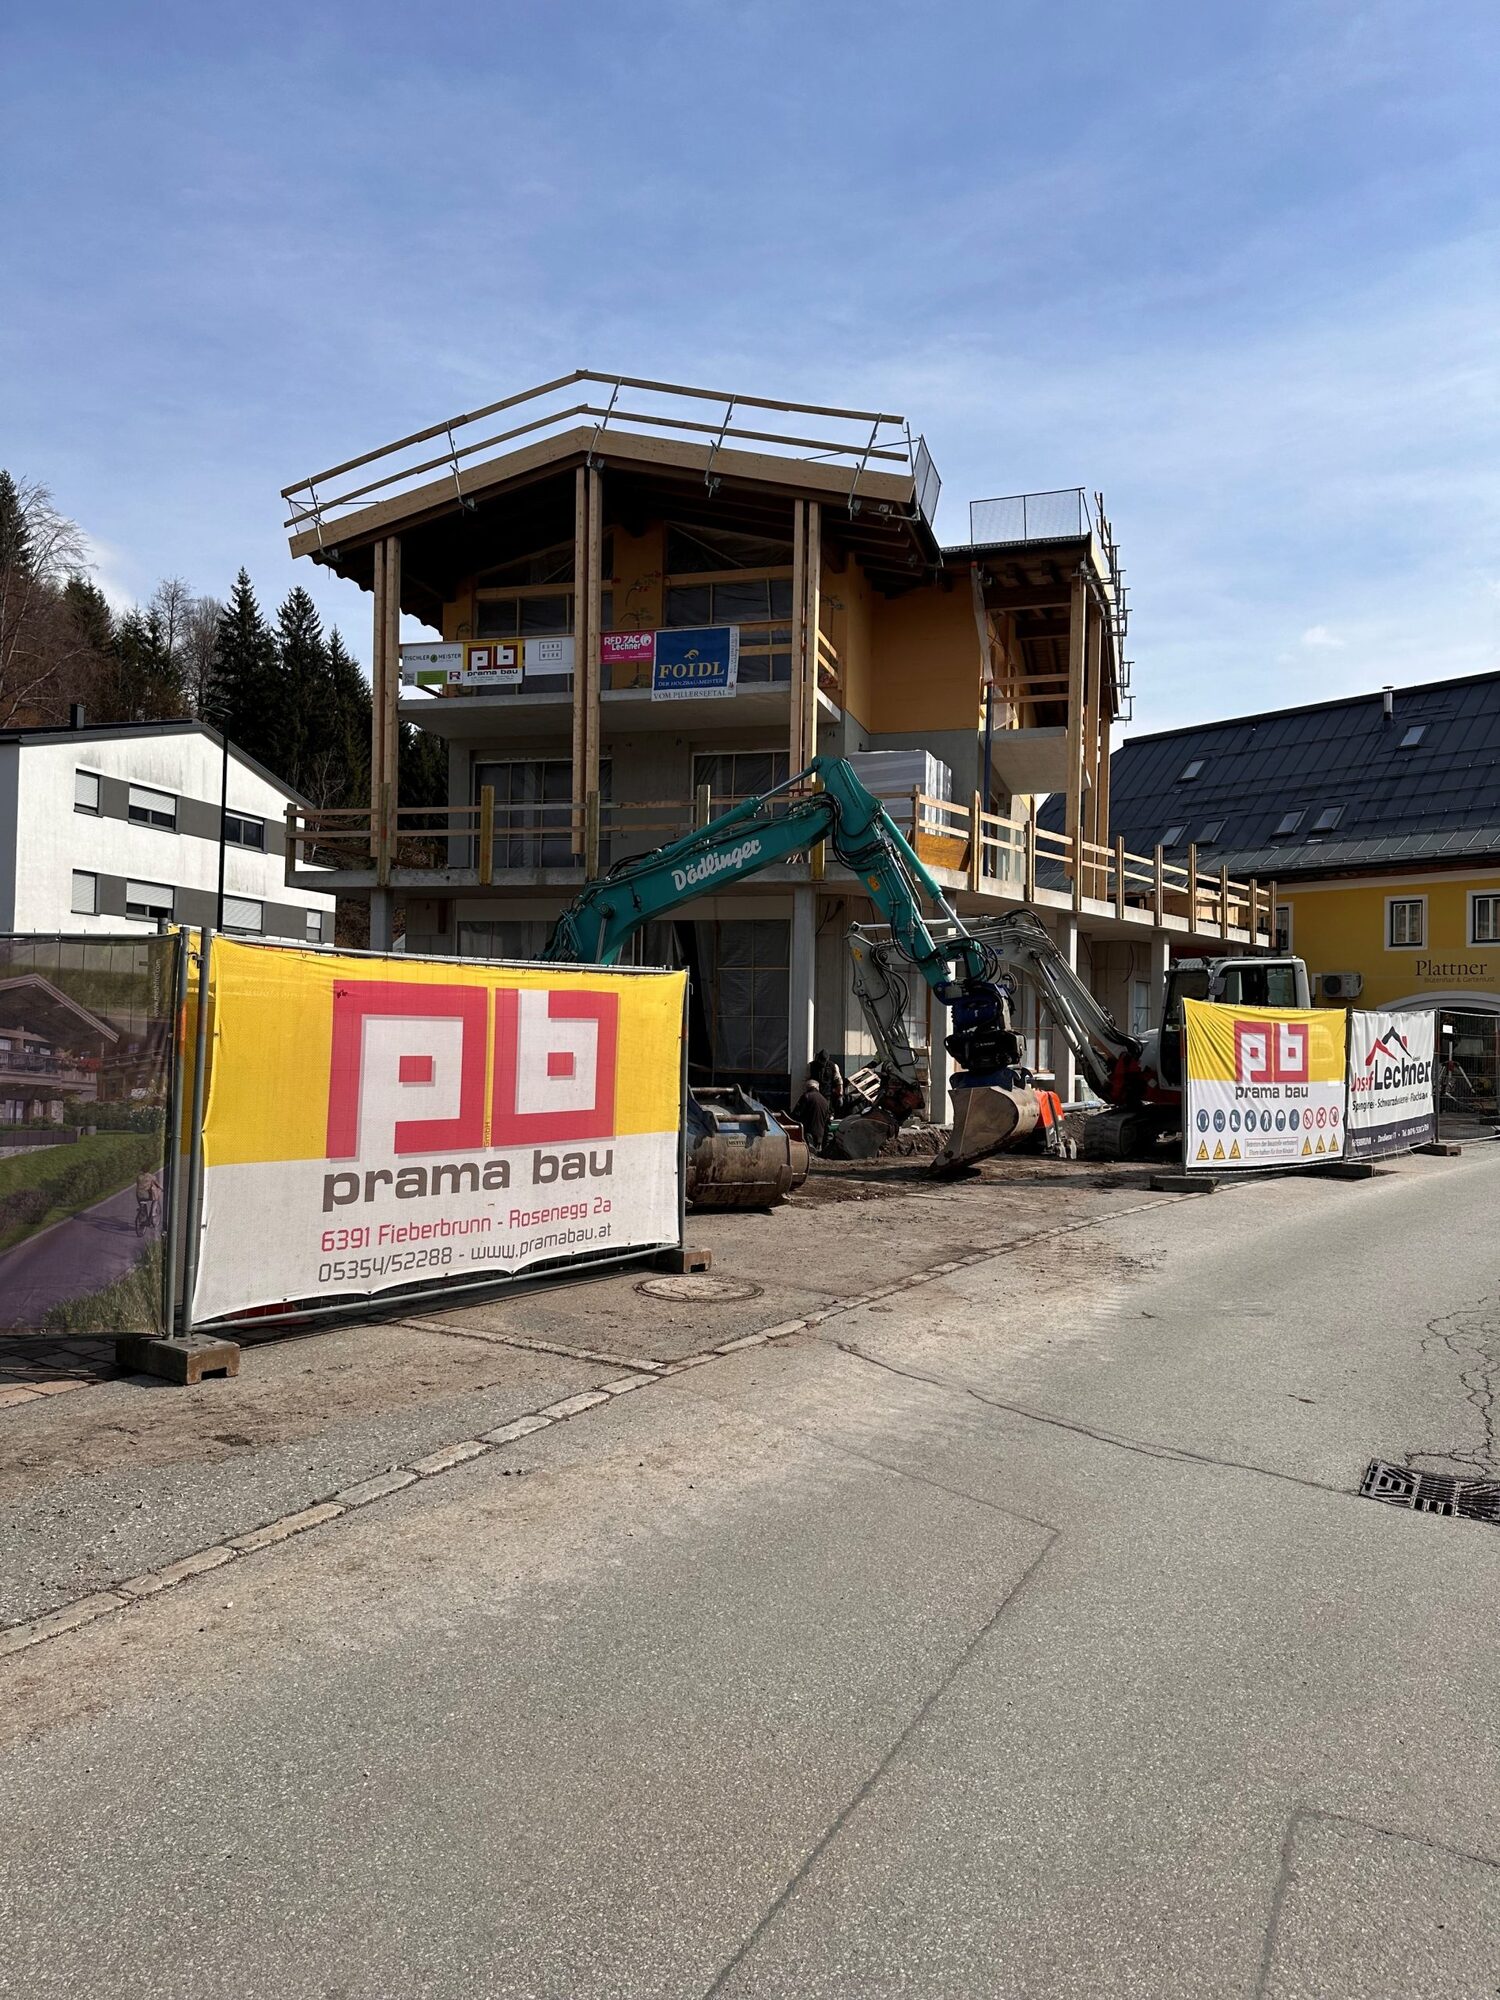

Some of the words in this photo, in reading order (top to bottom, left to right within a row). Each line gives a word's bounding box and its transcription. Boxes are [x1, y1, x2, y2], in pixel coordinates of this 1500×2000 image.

[404, 654, 430, 662] TISCHLER
[438, 652, 462, 661] MEISTER
[611, 642, 641, 651] Lechner
[467, 670, 497, 678] prama
[500, 668, 518, 676] bau
[658, 661, 725, 679] FOIDL
[671, 839, 762, 891] Dödlinger
[1415, 959, 1488, 976] Plattner
[1374, 1057, 1431, 1091] Lechner
[1235, 1085, 1280, 1100] prama
[1285, 1084, 1309, 1098] bau
[483, 1121, 491, 1148] GmbH
[322, 1158, 510, 1213] prama
[532, 1150, 613, 1185] bau
[321, 1227, 370, 1252] 6391
[378, 1217, 491, 1246] Fieberbrunn
[509, 1202, 588, 1229] Rosenegg
[593, 1197, 612, 1214] 2a
[318, 1246, 453, 1283] 05354/52288
[471, 1223, 612, 1259] www.pramabau.at
